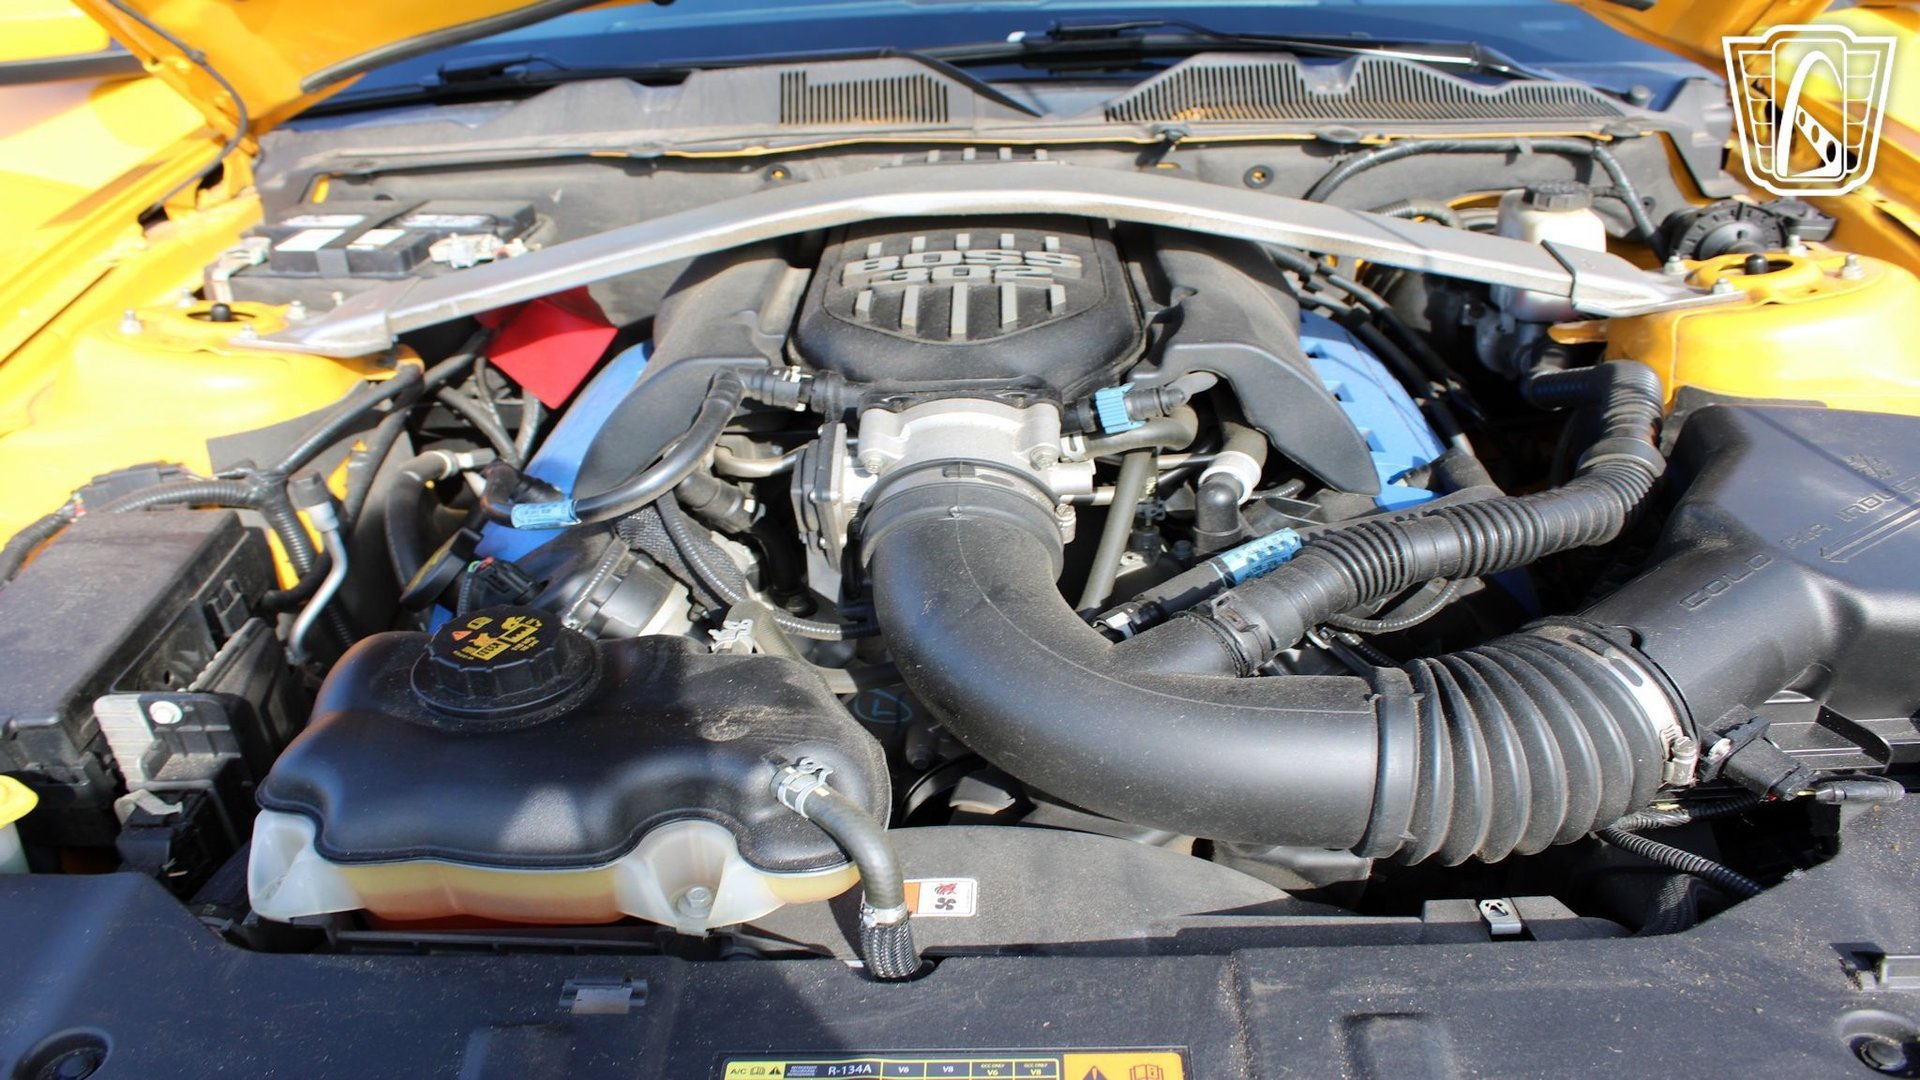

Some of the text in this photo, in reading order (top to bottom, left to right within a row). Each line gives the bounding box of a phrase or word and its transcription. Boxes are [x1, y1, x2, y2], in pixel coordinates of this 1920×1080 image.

[842, 249, 1083, 282] BOSS
[1679, 553, 1775, 611] COLD
[828, 1064, 872, 1076] R-134A
[898, 1066, 910, 1074] V6
